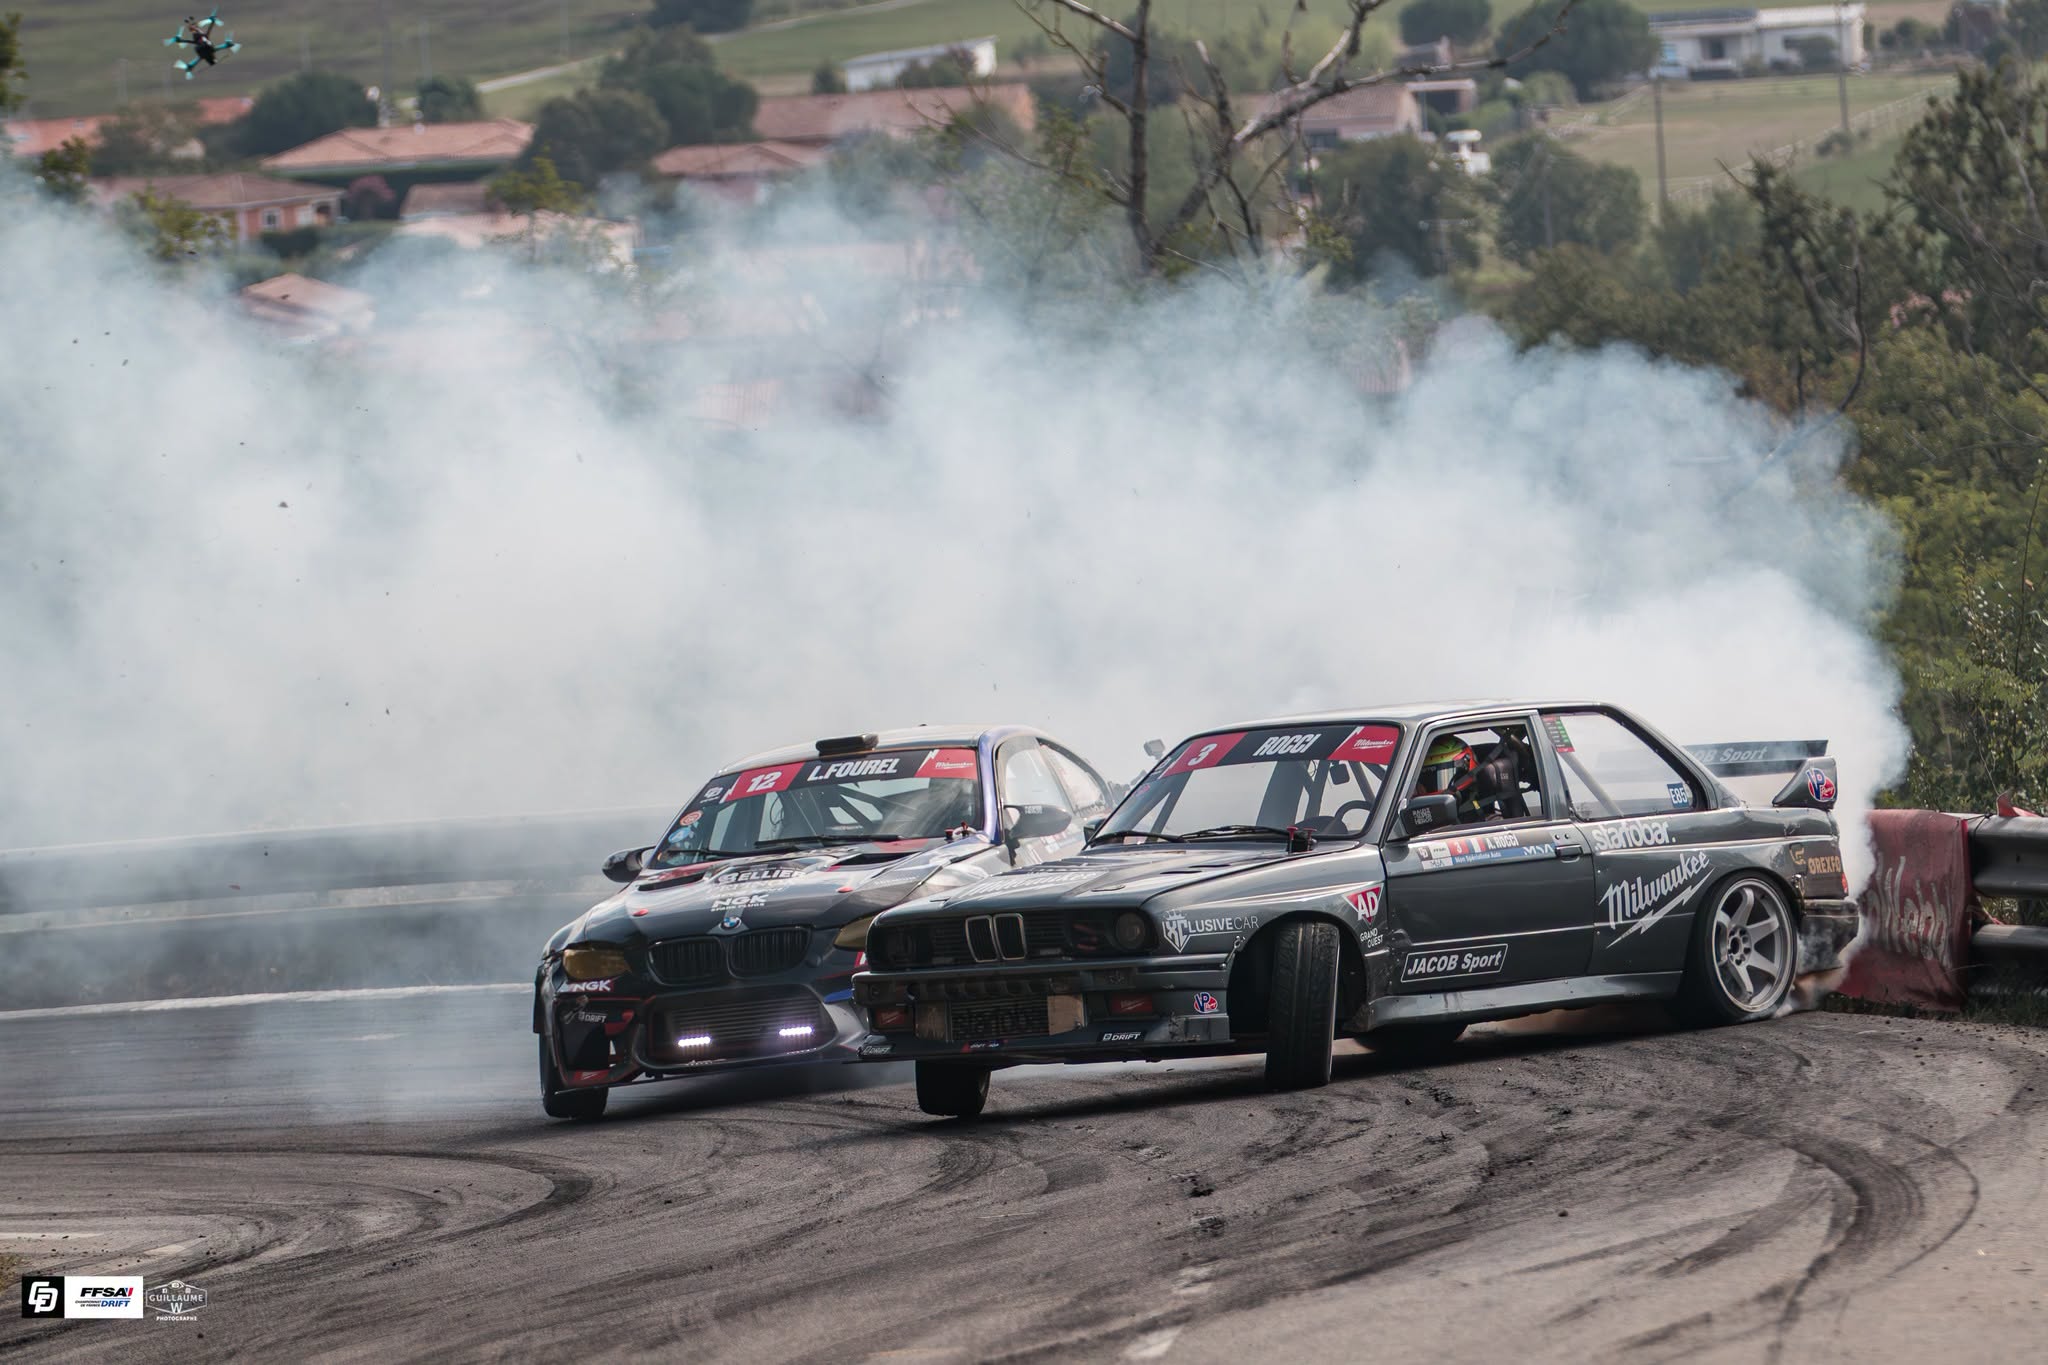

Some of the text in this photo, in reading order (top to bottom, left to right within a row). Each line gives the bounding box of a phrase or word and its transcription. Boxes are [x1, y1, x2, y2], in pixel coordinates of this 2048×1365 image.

[1252, 733, 1322, 756] ROCCI
[1353, 739, 1394, 748] Milwaukee
[1187, 743, 1218, 766] 3
[1720, 746, 1769, 762] Sport
[806, 758, 901, 782] L.FOUREL
[745, 771, 784, 794] 12
[1669, 787, 1688, 804] E85
[1598, 852, 1710, 930] Milwaukee
[711, 894, 769, 909] NGK
[1357, 891, 1378, 921] AD
[1360, 927, 1378, 942] GRAND
[1367, 934, 1384, 948] OUEST
[1407, 950, 1502, 976] JACOB Sport
[572, 980, 611, 992] NGK
[585, 1014, 607, 1023] DRIFT
[1111, 1033, 1141, 1042] DRIFT
